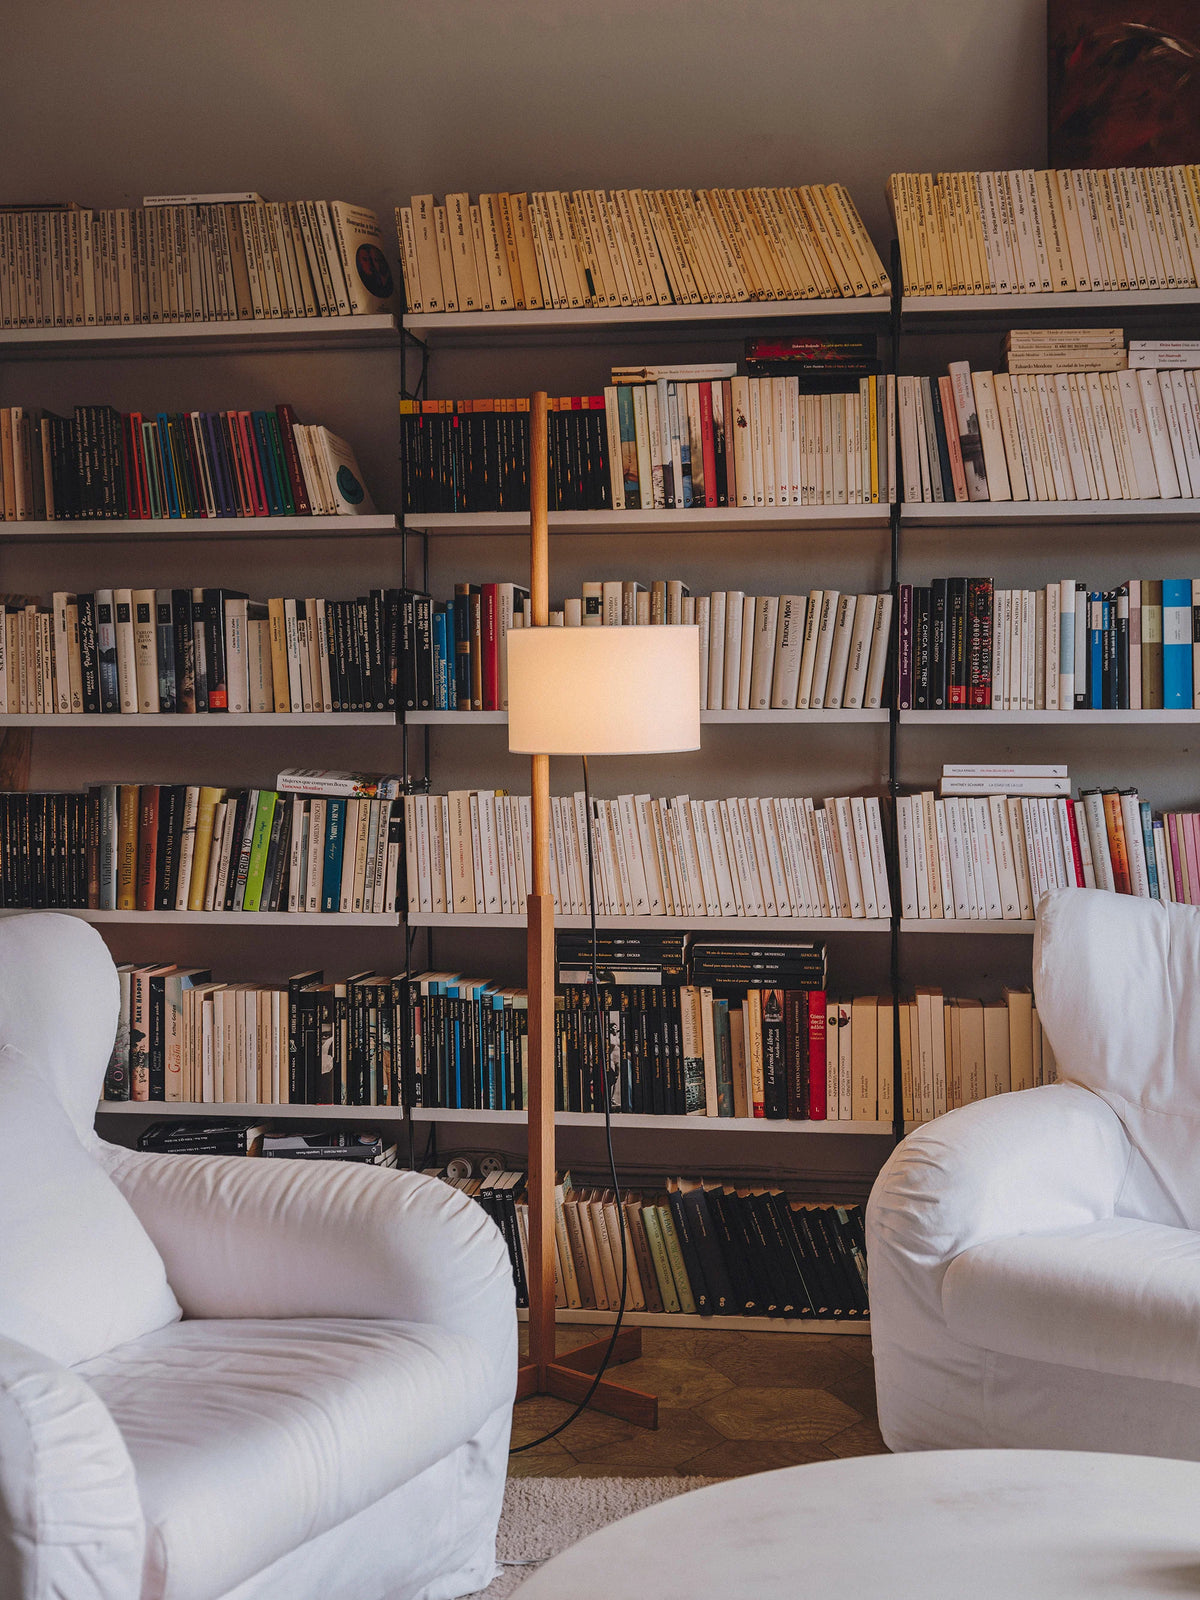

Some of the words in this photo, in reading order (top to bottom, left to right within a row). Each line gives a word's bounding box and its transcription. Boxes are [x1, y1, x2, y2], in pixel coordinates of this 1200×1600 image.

[783, 600, 791, 618] MOIX
[922, 613, 927, 621] LA
[782, 620, 790, 648] TERENCI
[242, 839, 251, 848] YO
[103, 842, 113, 885] Vilallonga
[123, 842, 133, 885] Vilallonga
[142, 843, 152, 886] Vilallonga
[238, 851, 250, 885] QUERIDA
[168, 1044, 180, 1072] Geisha
[768, 1076, 774, 1084] La
